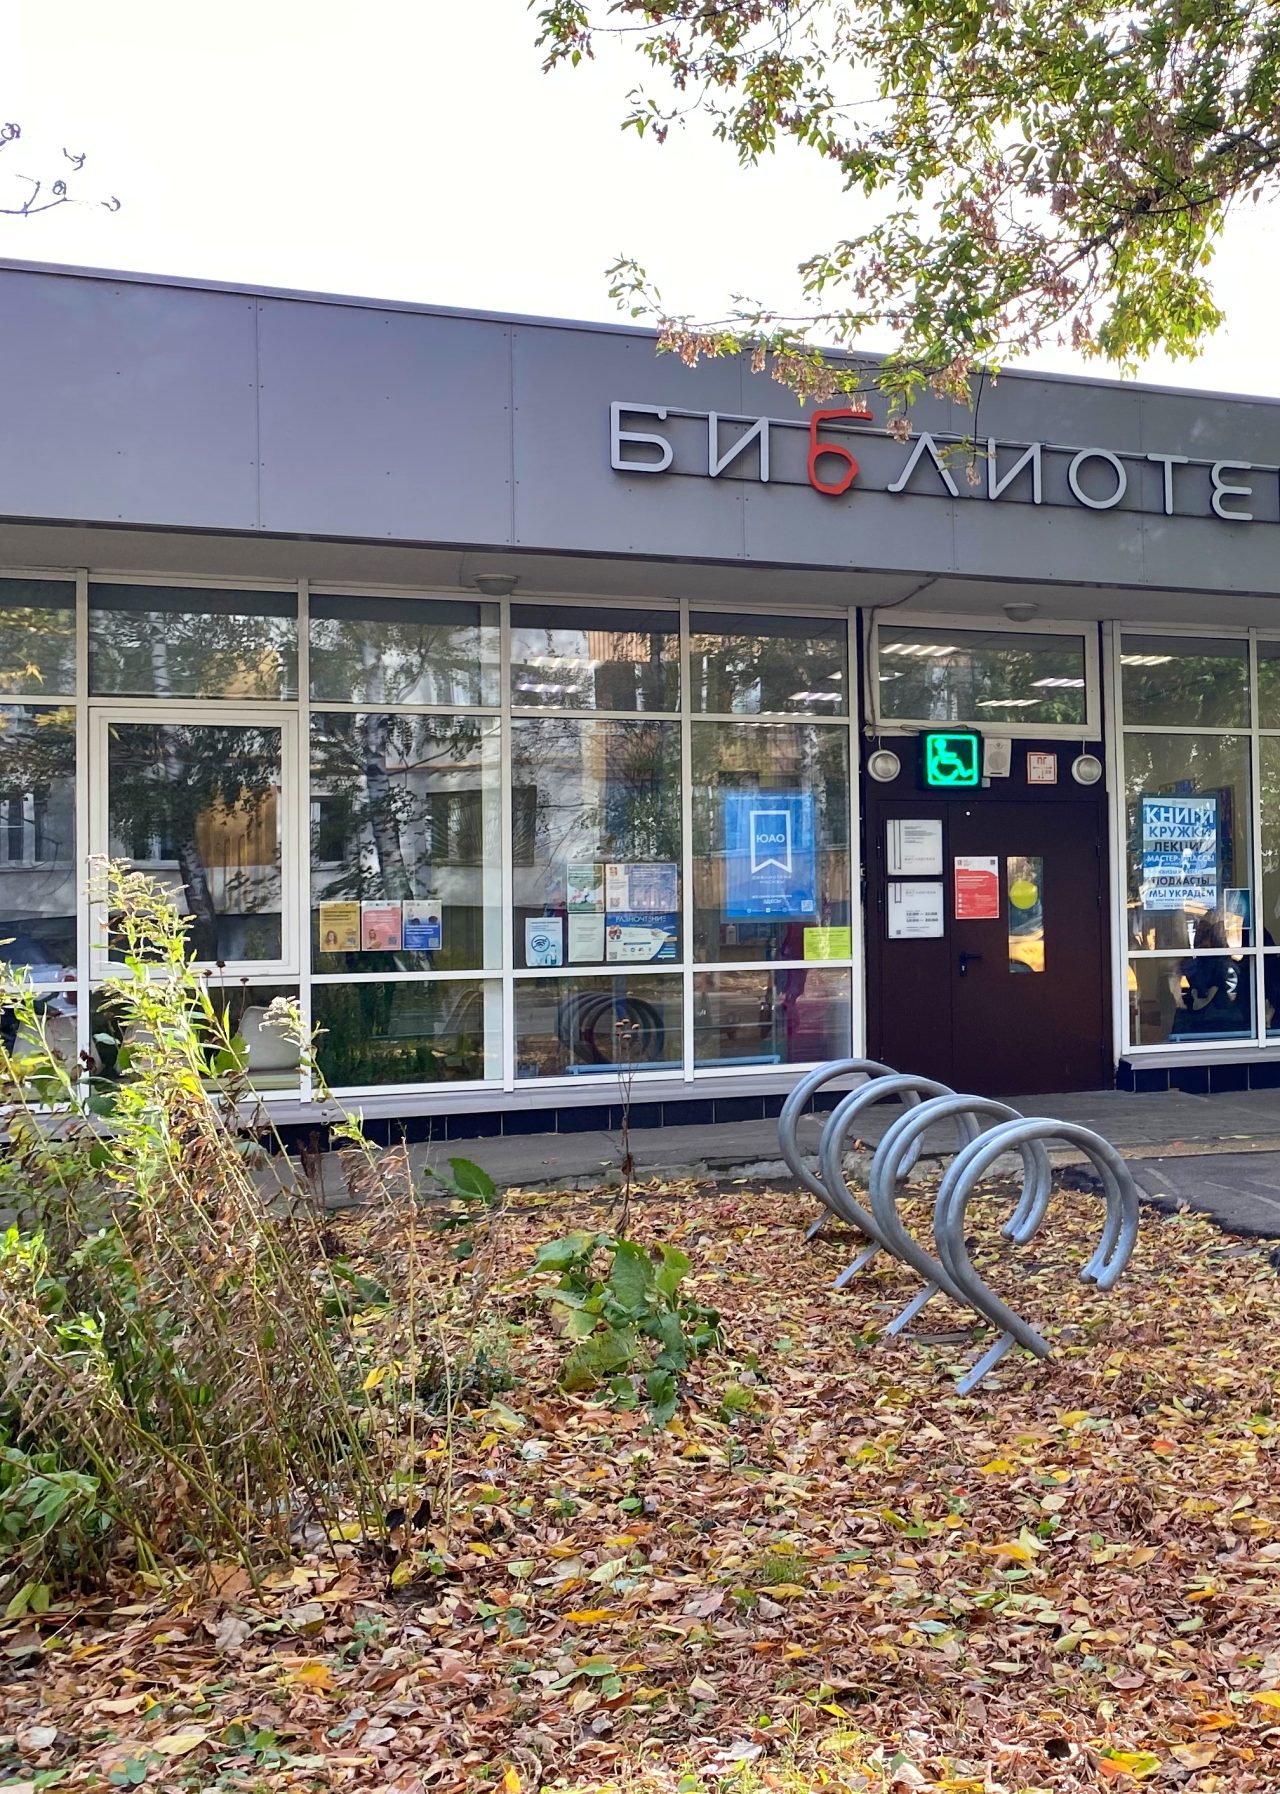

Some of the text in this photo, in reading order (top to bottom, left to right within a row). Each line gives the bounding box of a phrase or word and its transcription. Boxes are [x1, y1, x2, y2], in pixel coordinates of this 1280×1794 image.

[1146, 807, 1213, 824] КНИГИ
[1149, 826, 1211, 837] КРУЖКИ
[756, 833, 785, 843] ЮАО
[1153, 841, 1204, 852] ЛЕКЦИ
[1152, 877, 1210, 886] ПОДКАСТЫ
